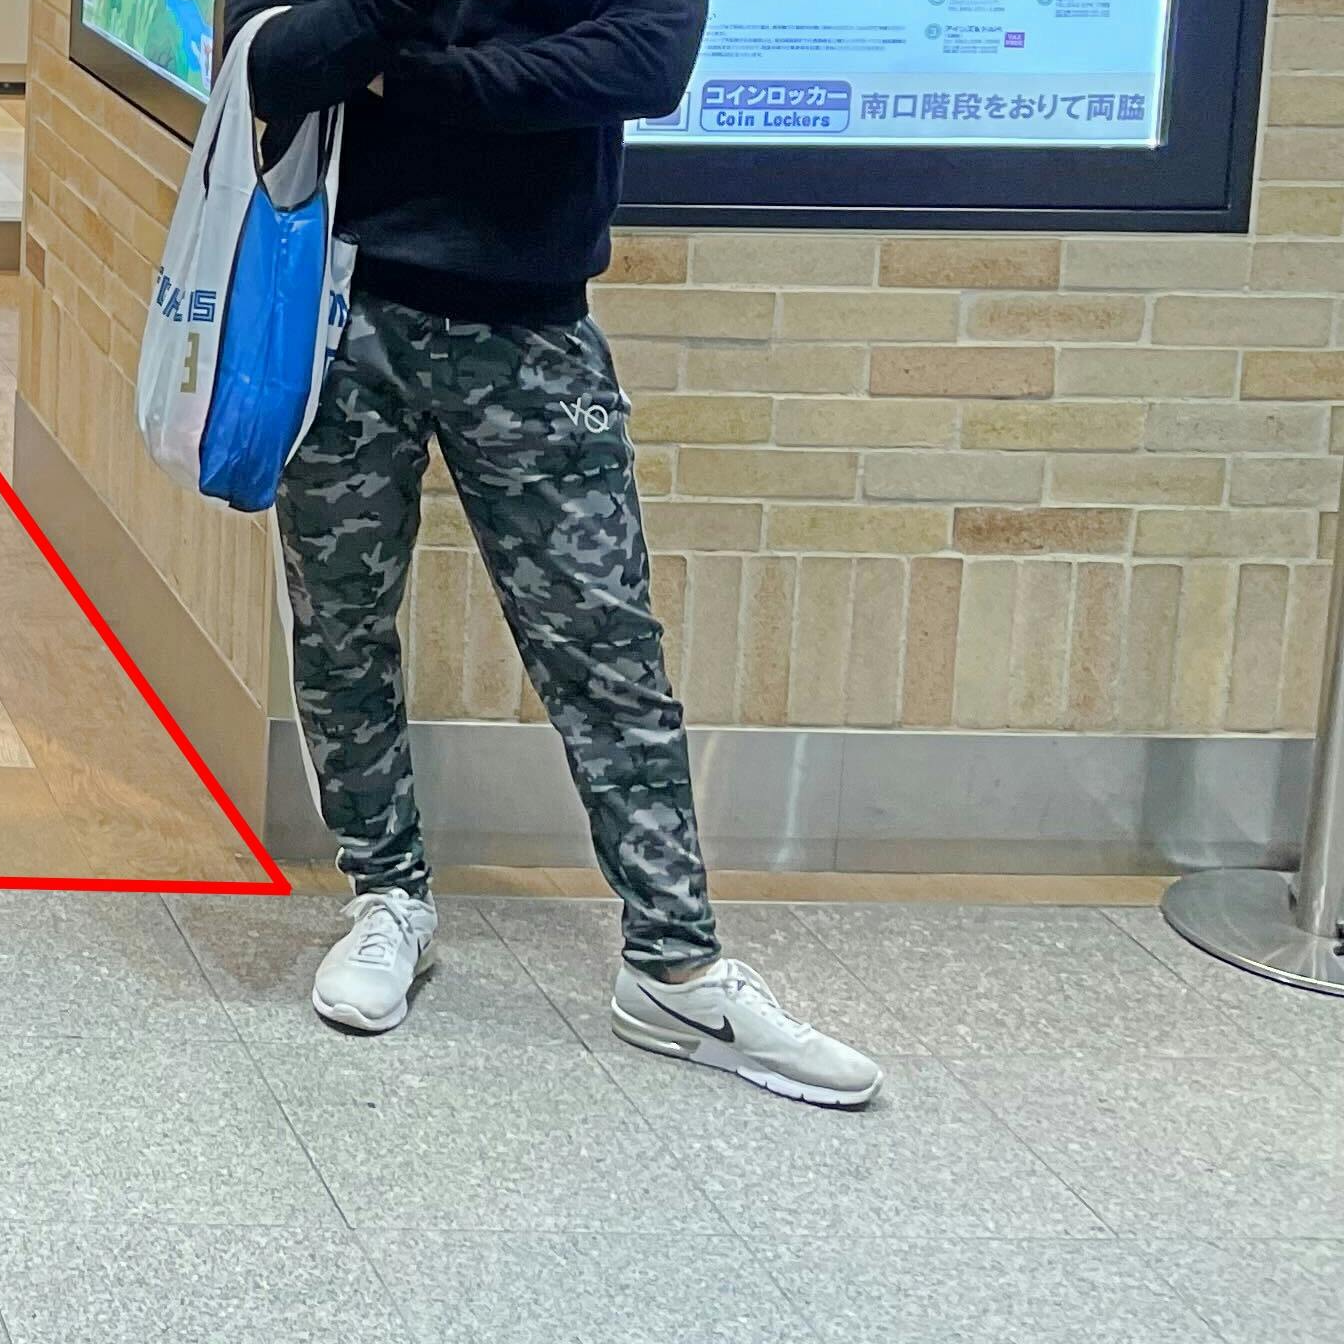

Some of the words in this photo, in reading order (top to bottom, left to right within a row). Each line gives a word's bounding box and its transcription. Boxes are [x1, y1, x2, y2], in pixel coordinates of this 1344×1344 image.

[705, 86, 848, 106] コインロッカー
[859, 92, 1146, 122] 南口階段をおりて両脇
[716, 111, 755, 127] Coin
[763, 111, 831, 127] Lockers
